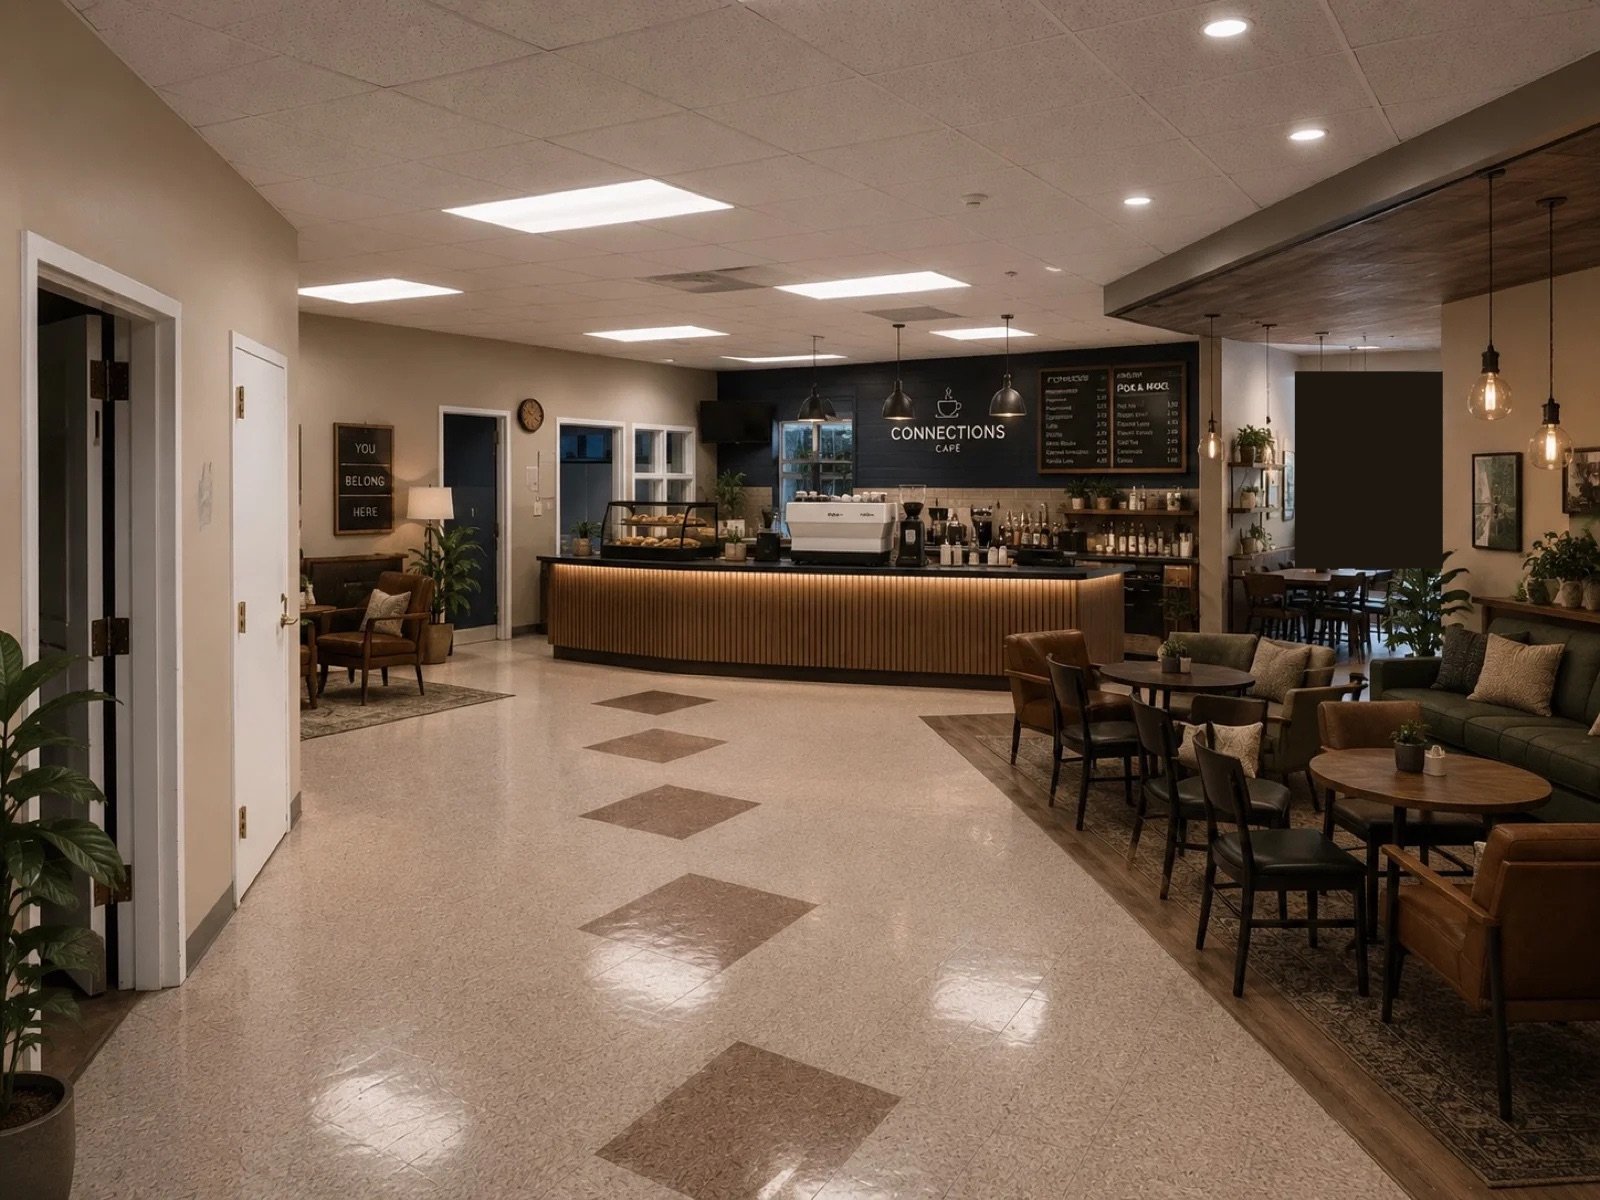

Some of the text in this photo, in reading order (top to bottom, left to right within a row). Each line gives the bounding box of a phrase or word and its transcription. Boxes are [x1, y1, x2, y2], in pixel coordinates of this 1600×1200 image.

[891, 424, 1006, 440] CONNECTIONS
[355, 443, 376, 454] YOU
[345, 475, 385, 487] BELONG
[353, 506, 379, 518] HERE
